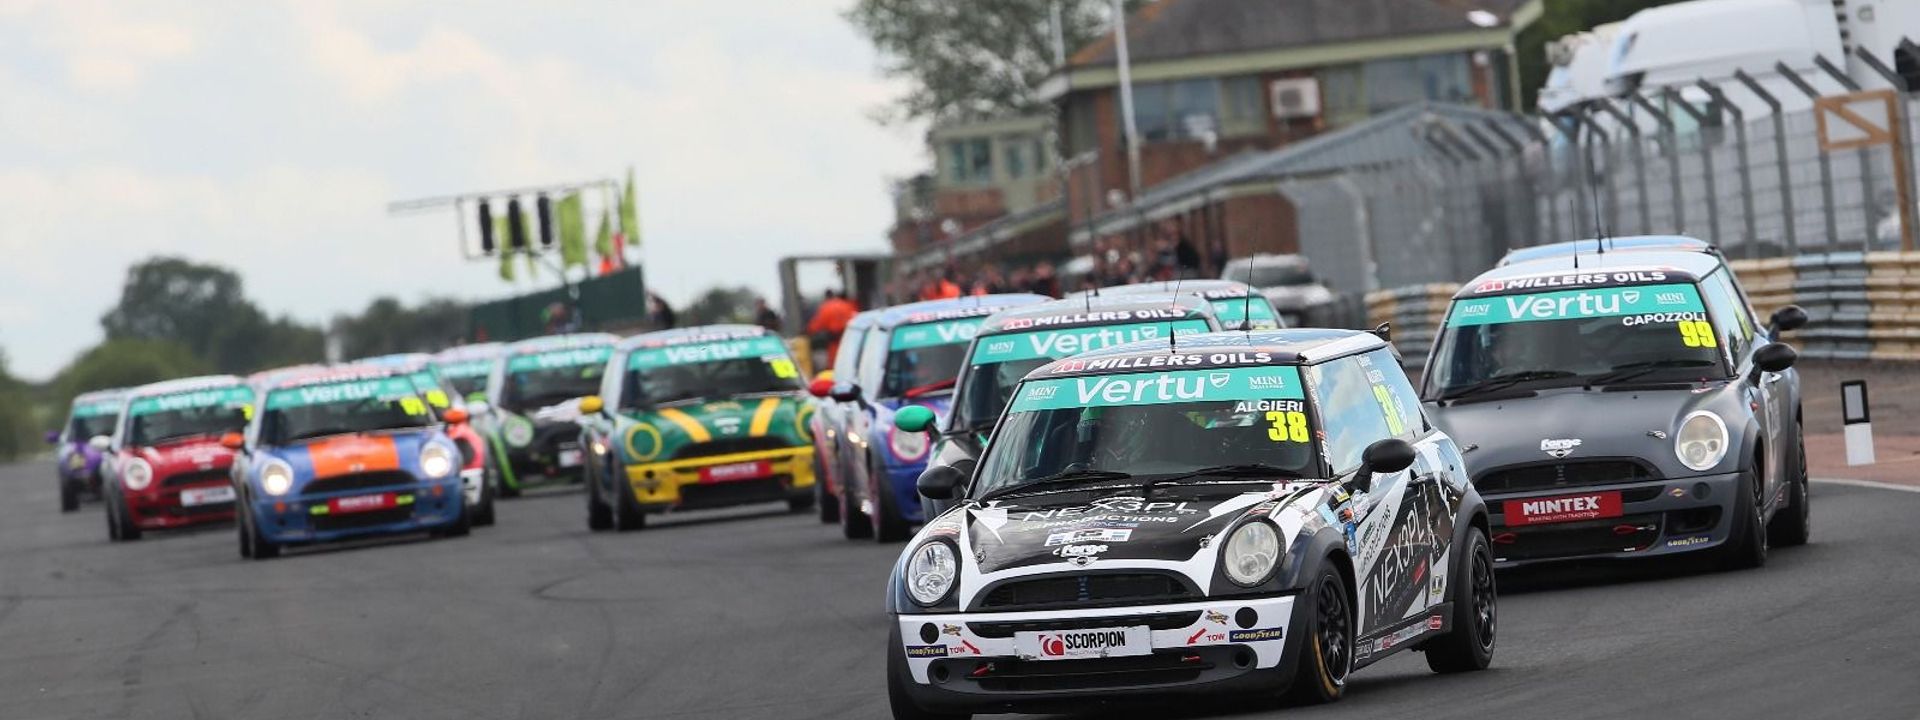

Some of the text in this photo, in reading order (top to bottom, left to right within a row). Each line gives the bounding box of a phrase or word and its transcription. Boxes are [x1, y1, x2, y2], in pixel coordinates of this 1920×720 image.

[1507, 270, 1666, 289] MILLERS OILS
[1506, 292, 1620, 319] Vertu
[1035, 309, 1186, 326] MILLERS OILS
[1622, 312, 1707, 326] CAPOZZOLI
[1029, 328, 1140, 356] Vertu
[1678, 321, 1717, 348] 99
[665, 343, 742, 364] Vertu
[1087, 352, 1272, 370] MILLERS OILS
[1076, 373, 1206, 405] Vertu
[1248, 376, 1285, 385] MINI
[301, 382, 373, 405] Vertu
[1235, 401, 1304, 413] ALGIERI
[1266, 411, 1309, 442] 38
[1522, 496, 1600, 516] MINTEX
[1373, 502, 1425, 615] NEX3PL
[1065, 631, 1126, 649] SCORPION
[1206, 633, 1225, 642] TOW
[1232, 629, 1281, 640] GOODYEAR
[907, 646, 946, 656] GOODYEAR
[949, 646, 966, 654] TOW
